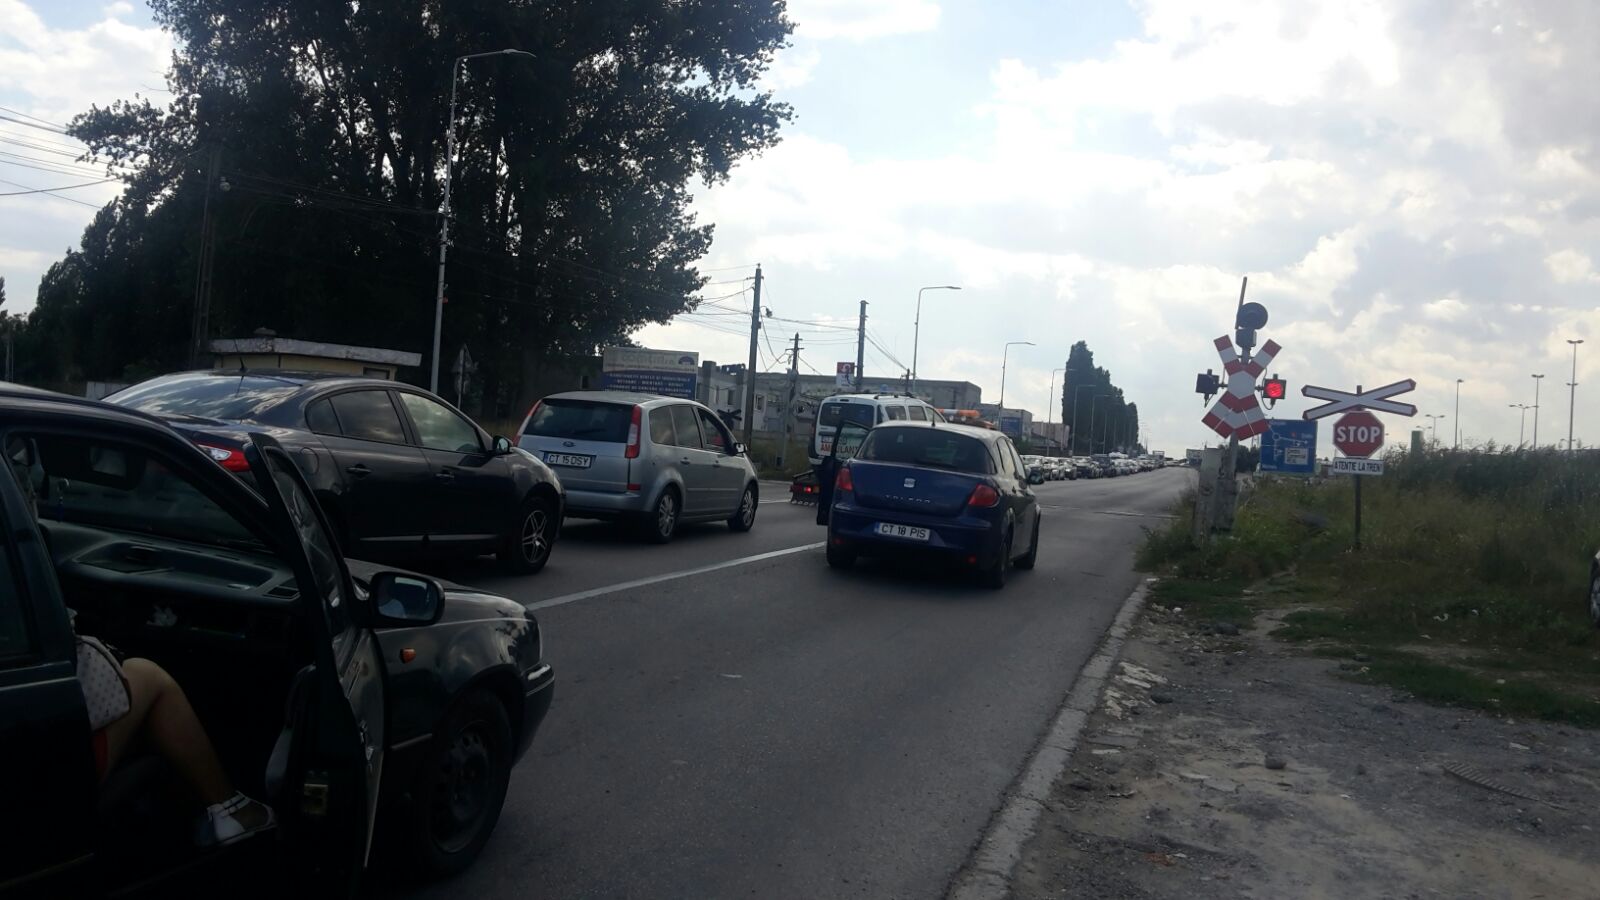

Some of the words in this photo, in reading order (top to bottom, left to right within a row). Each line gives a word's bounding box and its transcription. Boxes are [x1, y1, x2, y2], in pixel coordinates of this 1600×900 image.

[1336, 426, 1381, 443] STOP
[548, 454, 561, 464] CT
[562, 455, 571, 464] 15
[1358, 462, 1367, 472] LA
[881, 524, 894, 534] CT
[897, 526, 907, 536] 18
[909, 527, 927, 538] PIS
